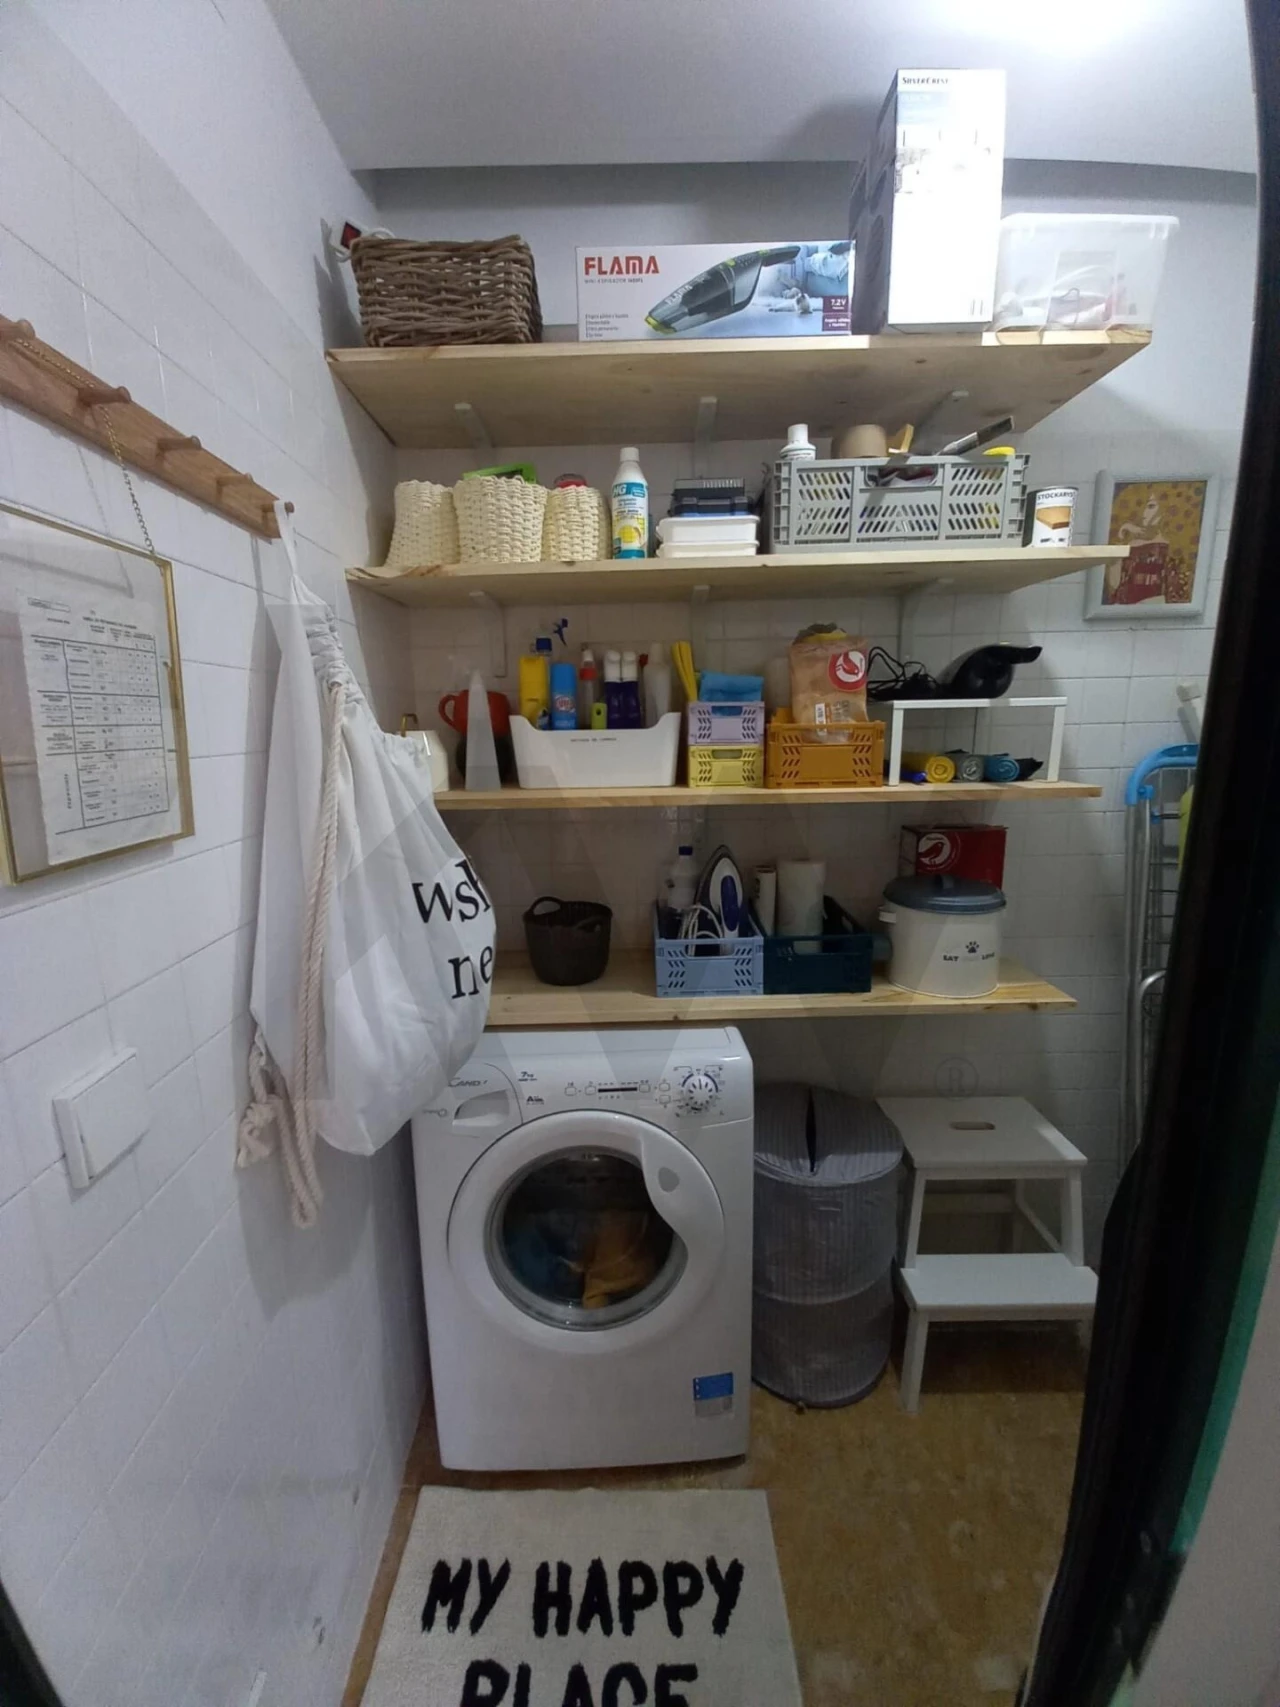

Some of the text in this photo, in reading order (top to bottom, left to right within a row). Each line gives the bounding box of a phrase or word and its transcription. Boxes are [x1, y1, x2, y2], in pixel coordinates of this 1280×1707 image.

[584, 256, 660, 276] FLAMA
[421, 1554, 744, 1638] MY HAPPY
